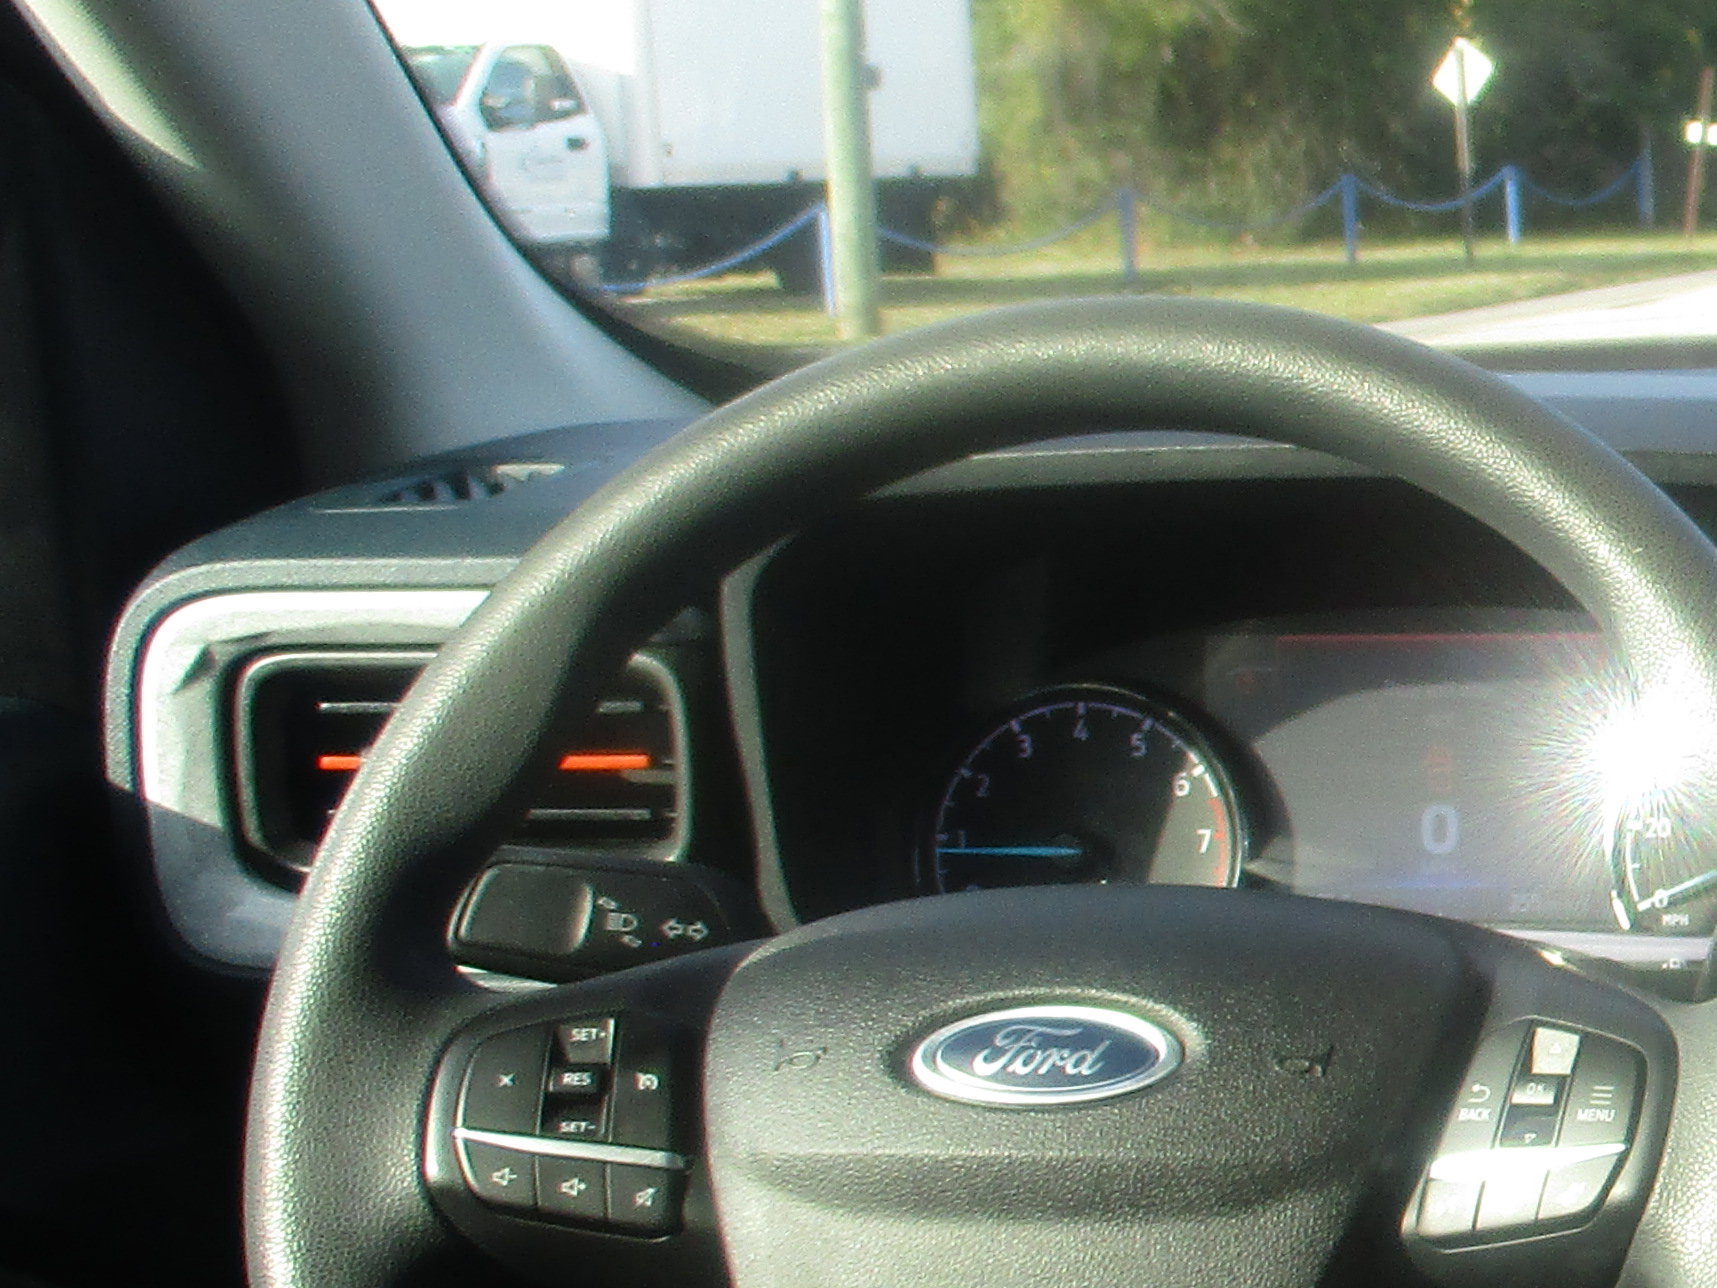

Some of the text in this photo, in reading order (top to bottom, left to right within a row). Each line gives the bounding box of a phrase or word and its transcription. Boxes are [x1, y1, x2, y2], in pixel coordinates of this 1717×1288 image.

[1073, 721, 1088, 741] 4
[1019, 734, 1033, 758] 3
[1130, 733, 1146, 757] 5
[975, 774, 990, 798] 2
[1173, 772, 1190, 797] 6
[1197, 829, 1212, 854] 7
[1422, 805, 1460, 854] 0
[971, 1024, 1112, 1077] Ford
[560, 1071, 592, 1087] RES
[1525, 1082, 1545, 1095] OK
[1458, 1108, 1491, 1122] BACK
[1576, 1108, 1615, 1122] MENU
